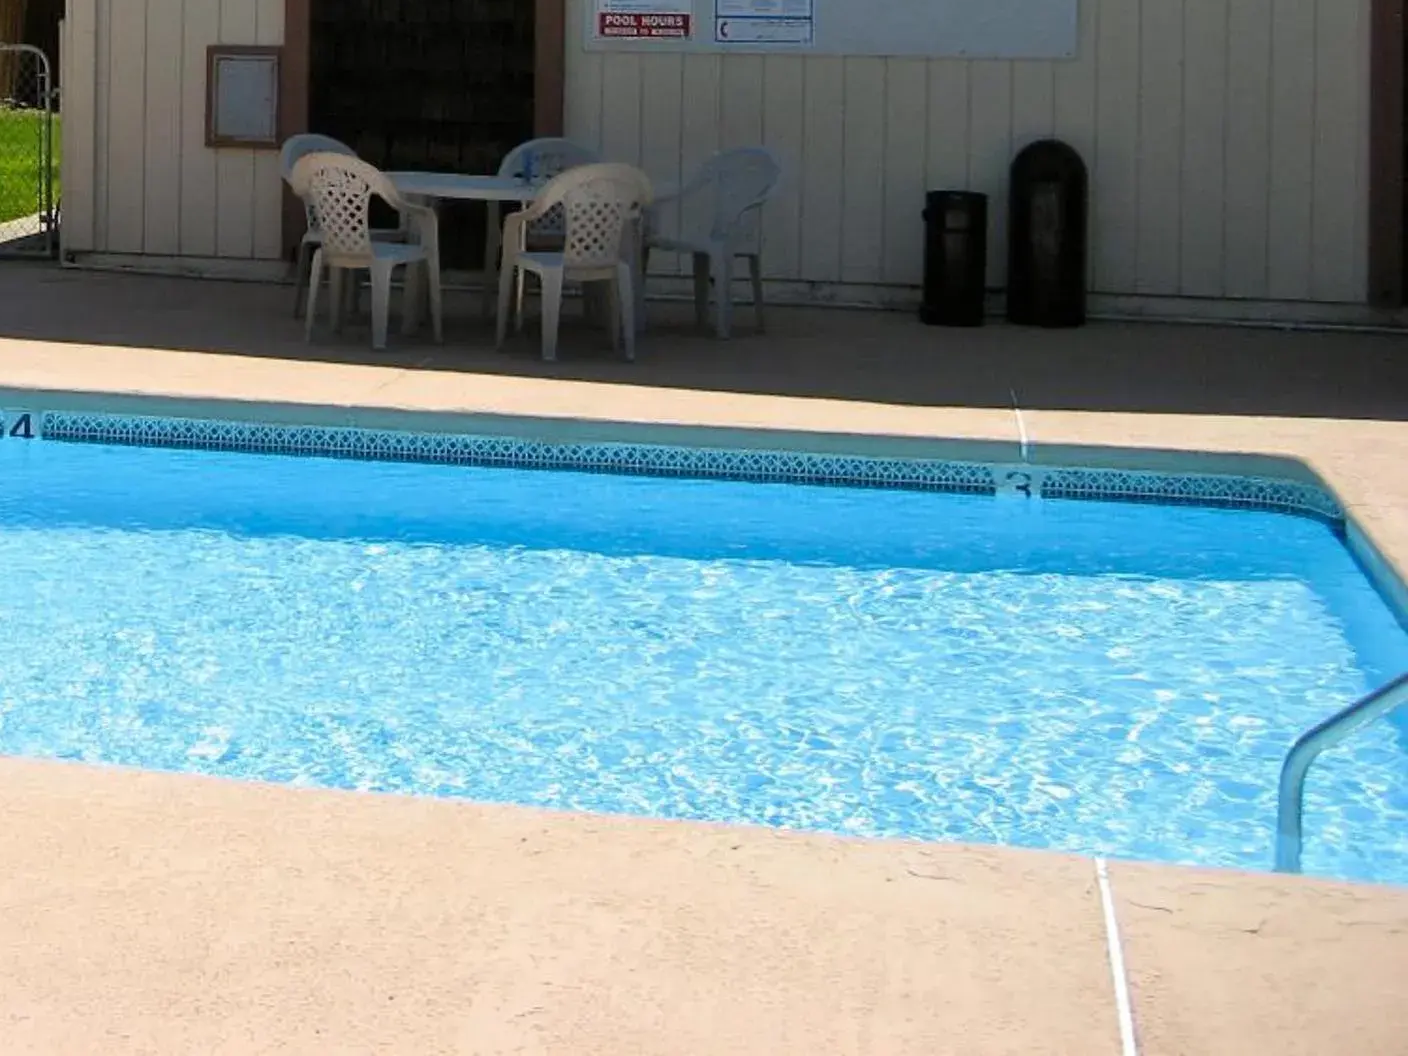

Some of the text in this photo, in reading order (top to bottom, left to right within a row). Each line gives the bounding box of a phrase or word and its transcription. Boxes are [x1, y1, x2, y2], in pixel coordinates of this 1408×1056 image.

[605, 15, 684, 26] POOL HOURS
[9, 413, 35, 438] 4
